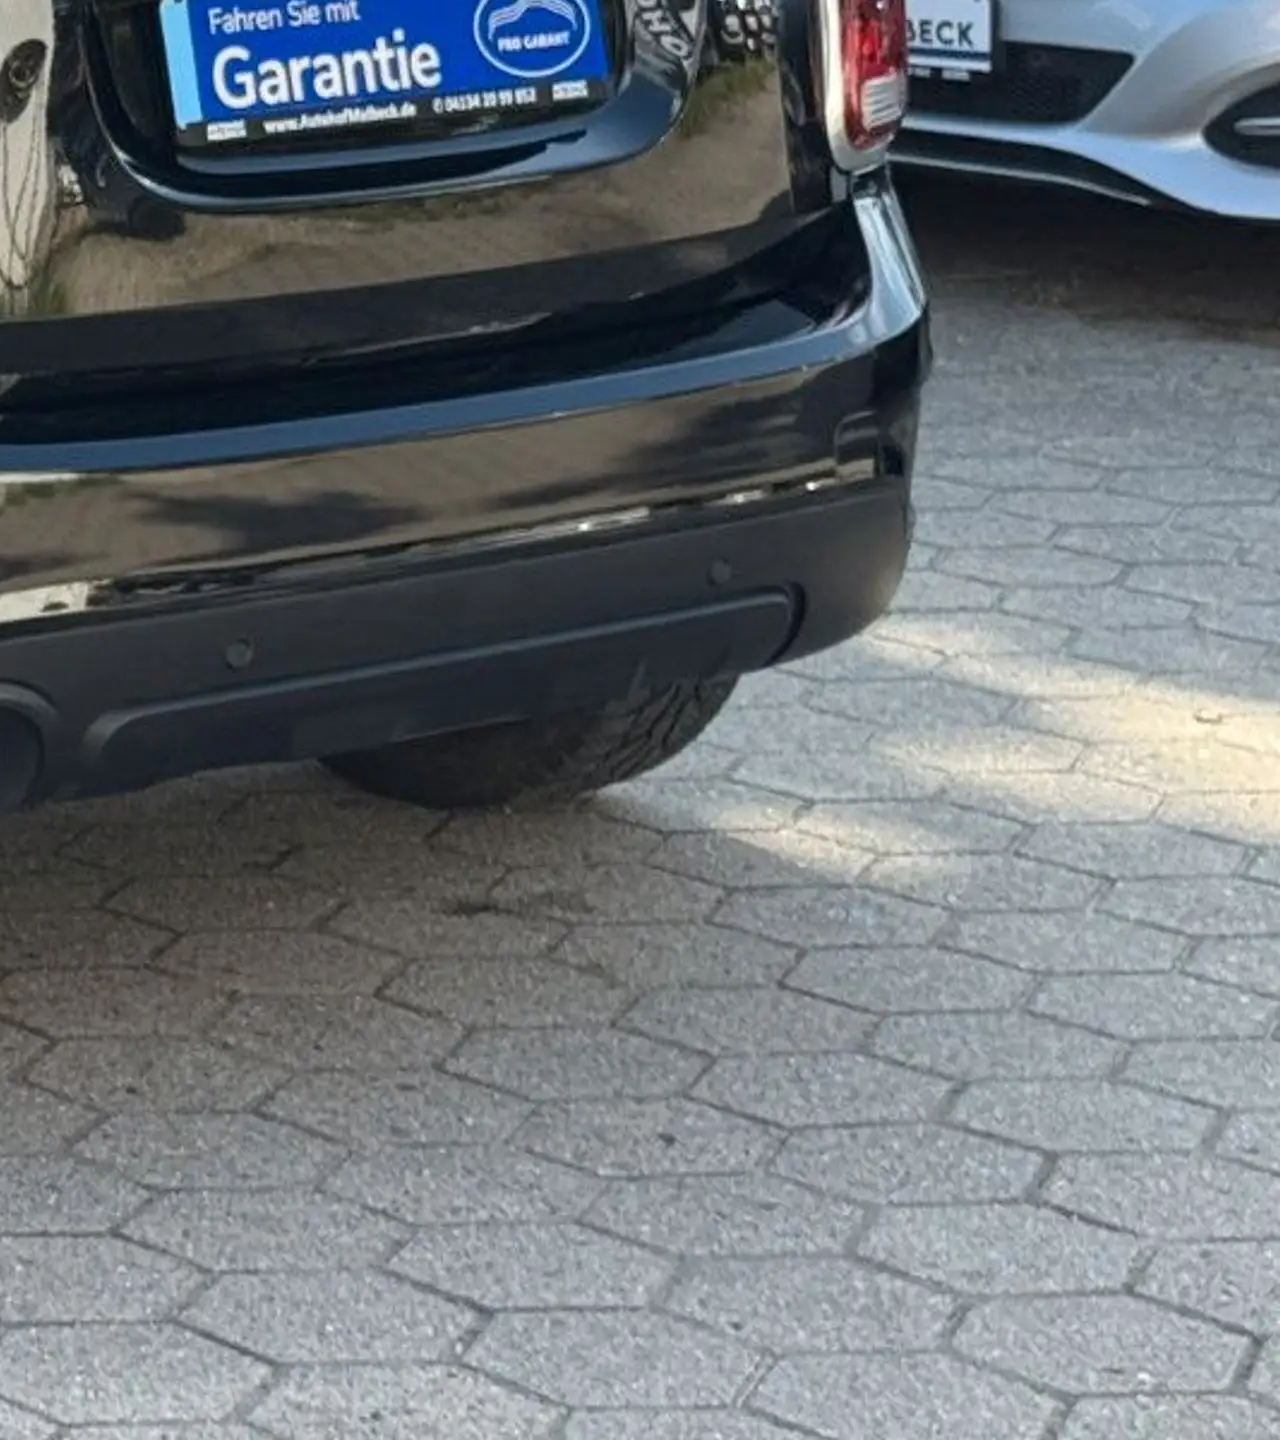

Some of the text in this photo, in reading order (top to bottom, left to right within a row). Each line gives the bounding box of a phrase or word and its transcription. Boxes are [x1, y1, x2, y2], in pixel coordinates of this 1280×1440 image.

[207, 6, 283, 35] Fahren
[286, 0, 321, 27] Sie
[212, 28, 442, 109] Garantie
